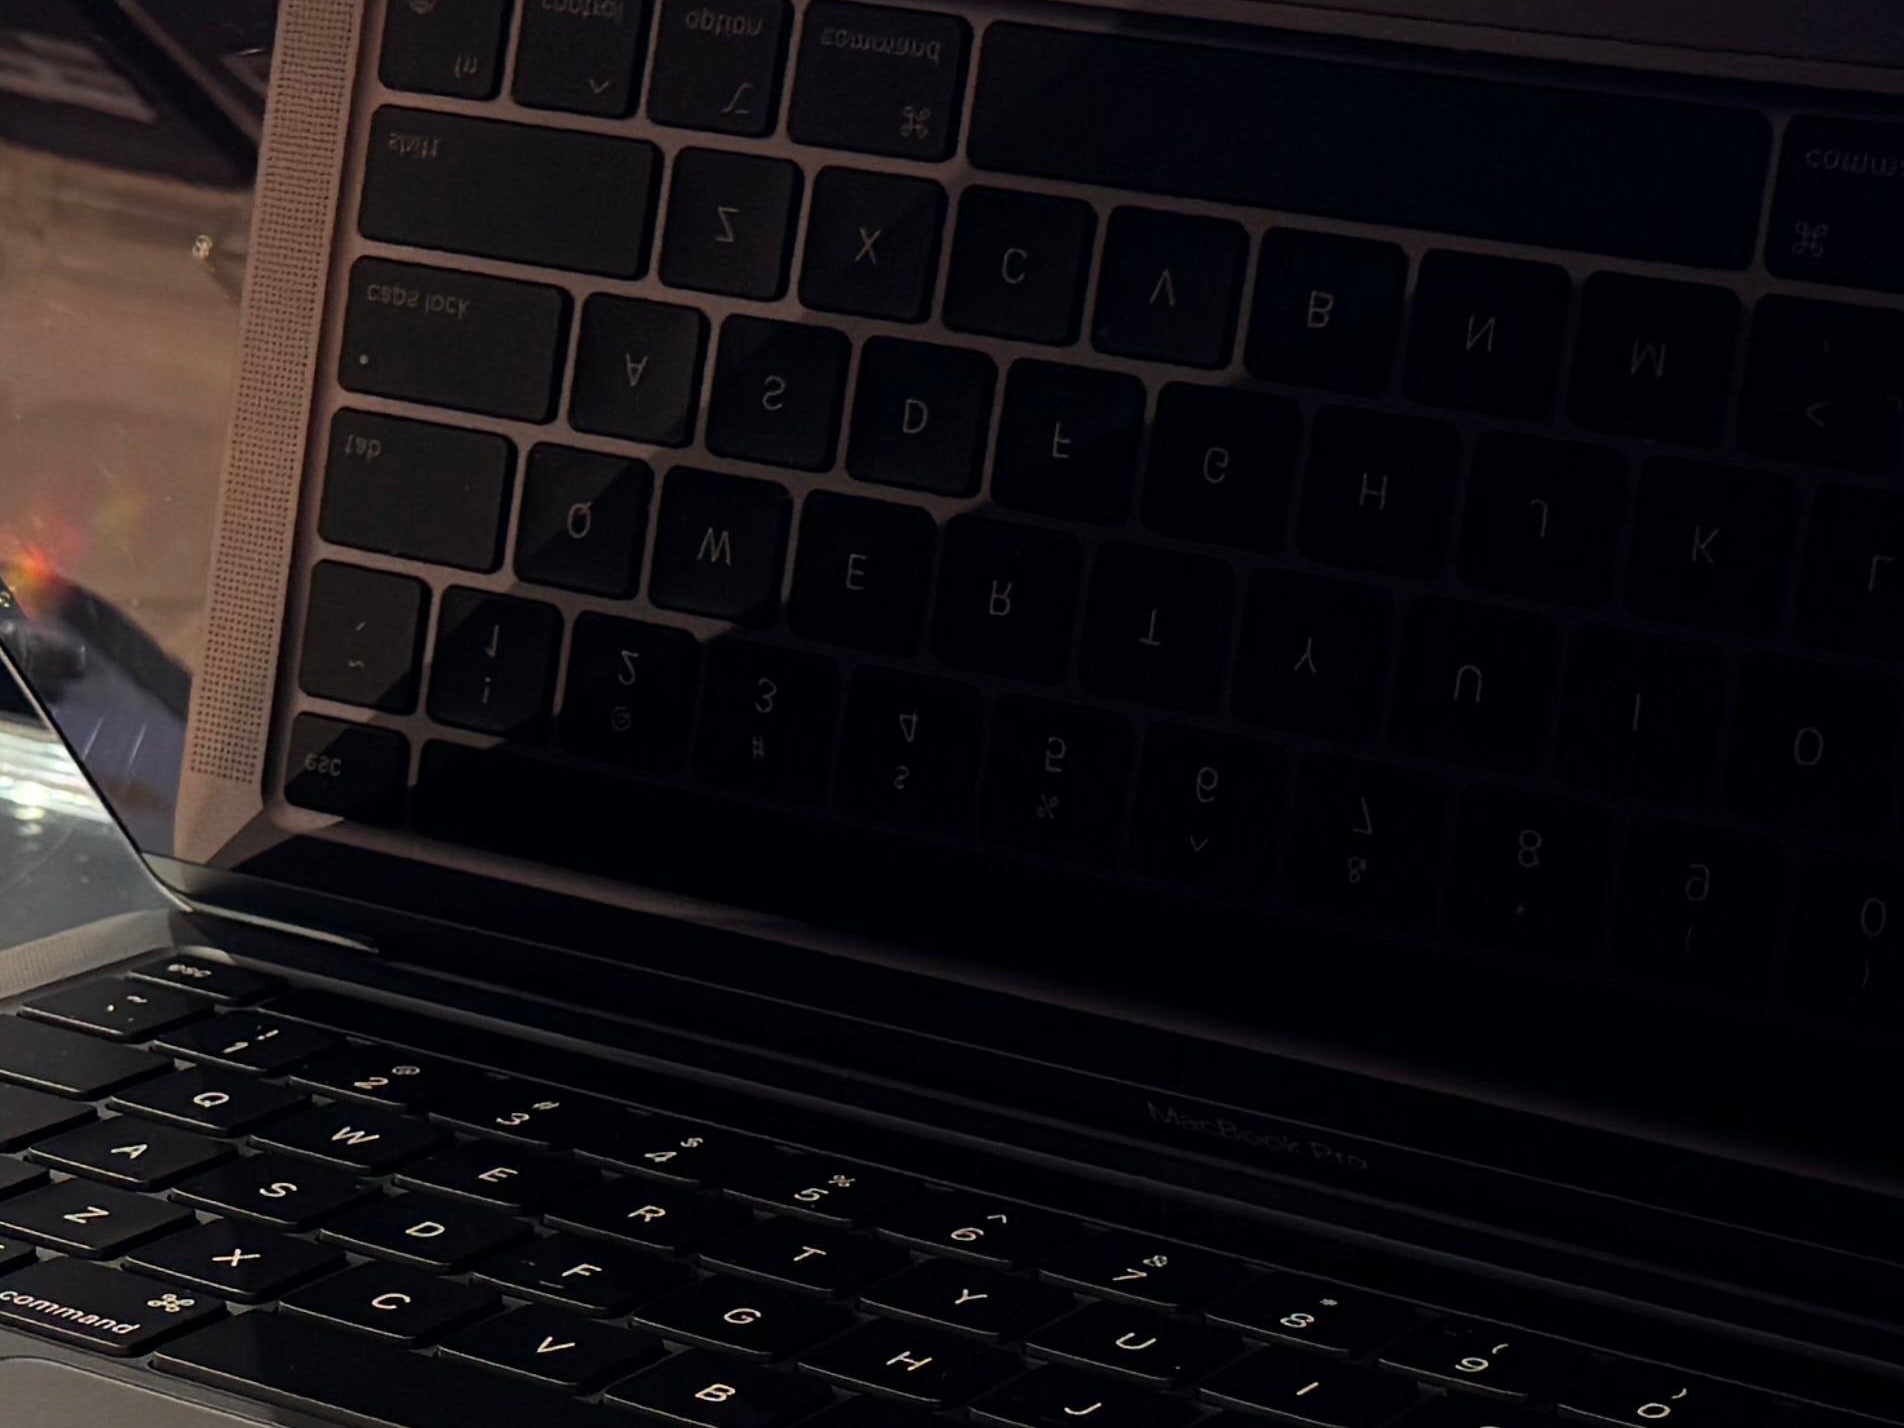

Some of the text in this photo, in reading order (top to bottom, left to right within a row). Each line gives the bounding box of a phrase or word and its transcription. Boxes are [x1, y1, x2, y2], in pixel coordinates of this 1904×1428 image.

[223, 1041, 249, 1054] 1
[353, 1076, 389, 1090] 2
[193, 1091, 230, 1108] Q
[495, 1112, 530, 1126] 3
[331, 1126, 380, 1145] W
[110, 1143, 148, 1159] A
[644, 1151, 678, 1163] 4
[478, 1166, 518, 1183] E
[259, 1182, 298, 1198] S
[793, 1187, 829, 1202] 5
[63, 1206, 109, 1224] Z
[627, 1204, 666, 1223] R
[405, 1221, 446, 1238] D
[950, 1226, 985, 1242] 6
[212, 1248, 261, 1267] X
[793, 1245, 827, 1262] T
[561, 1263, 603, 1277] F
[1112, 1267, 1148, 1282] 7
[371, 1292, 411, 1310] C
[954, 1288, 988, 1305] Y
[723, 1307, 762, 1325] G
[1279, 1312, 1315, 1328] 8
[536, 1336, 576, 1353] V
[1115, 1332, 1157, 1350] U
[886, 1350, 933, 1372] H
[1454, 1356, 1489, 1373] 9
[694, 1383, 736, 1402] B
[1296, 1381, 1319, 1396] I
[1063, 1402, 1102, 1416] J
[1636, 1402, 1671, 1419] 0
